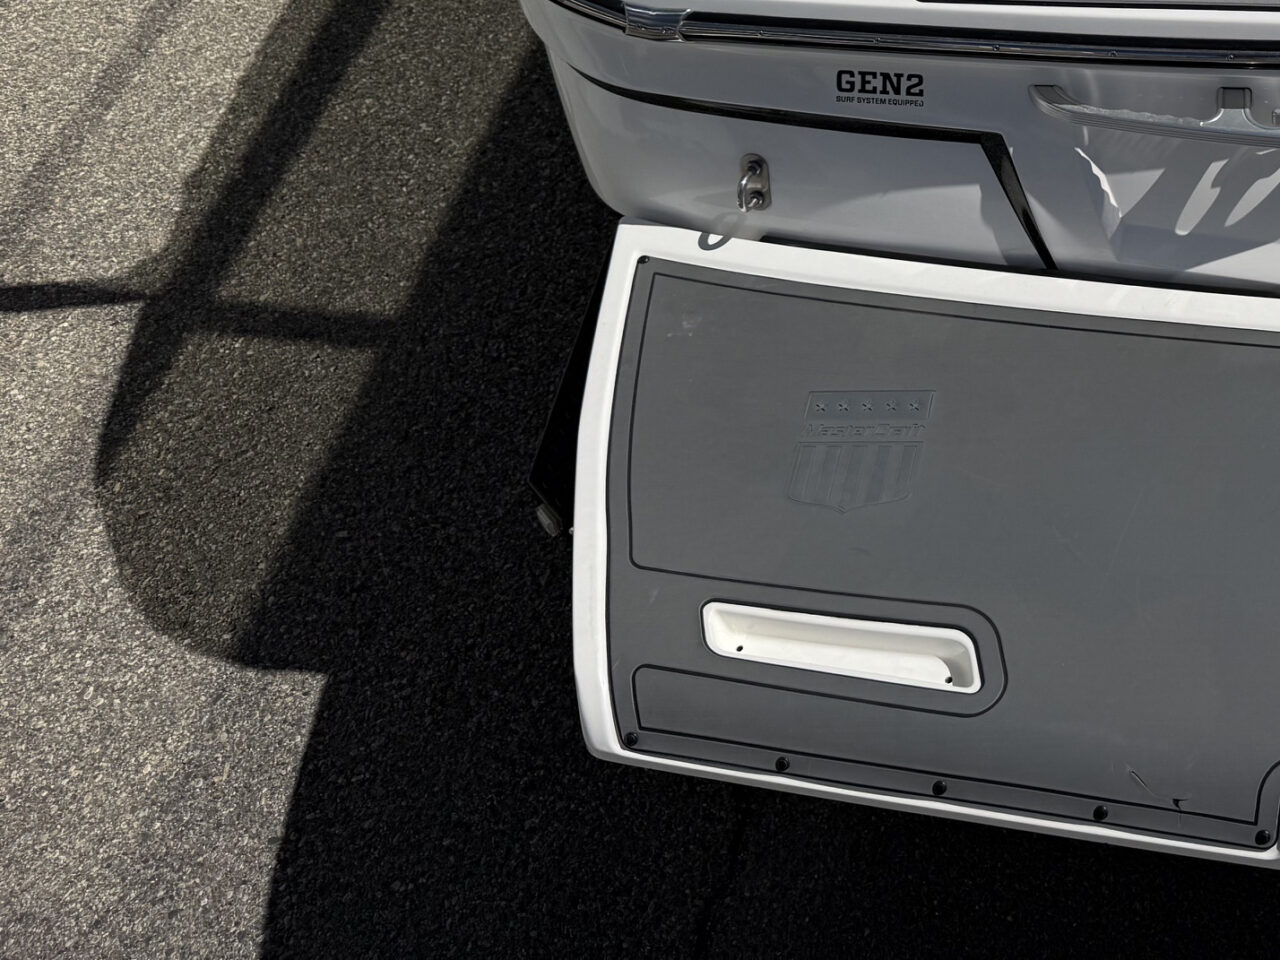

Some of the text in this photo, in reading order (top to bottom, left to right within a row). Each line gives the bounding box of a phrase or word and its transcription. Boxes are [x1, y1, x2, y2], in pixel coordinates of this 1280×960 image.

[836, 69, 924, 97] GEN2
[835, 95, 856, 104] SURF
[857, 96, 887, 105] SYSTEM
